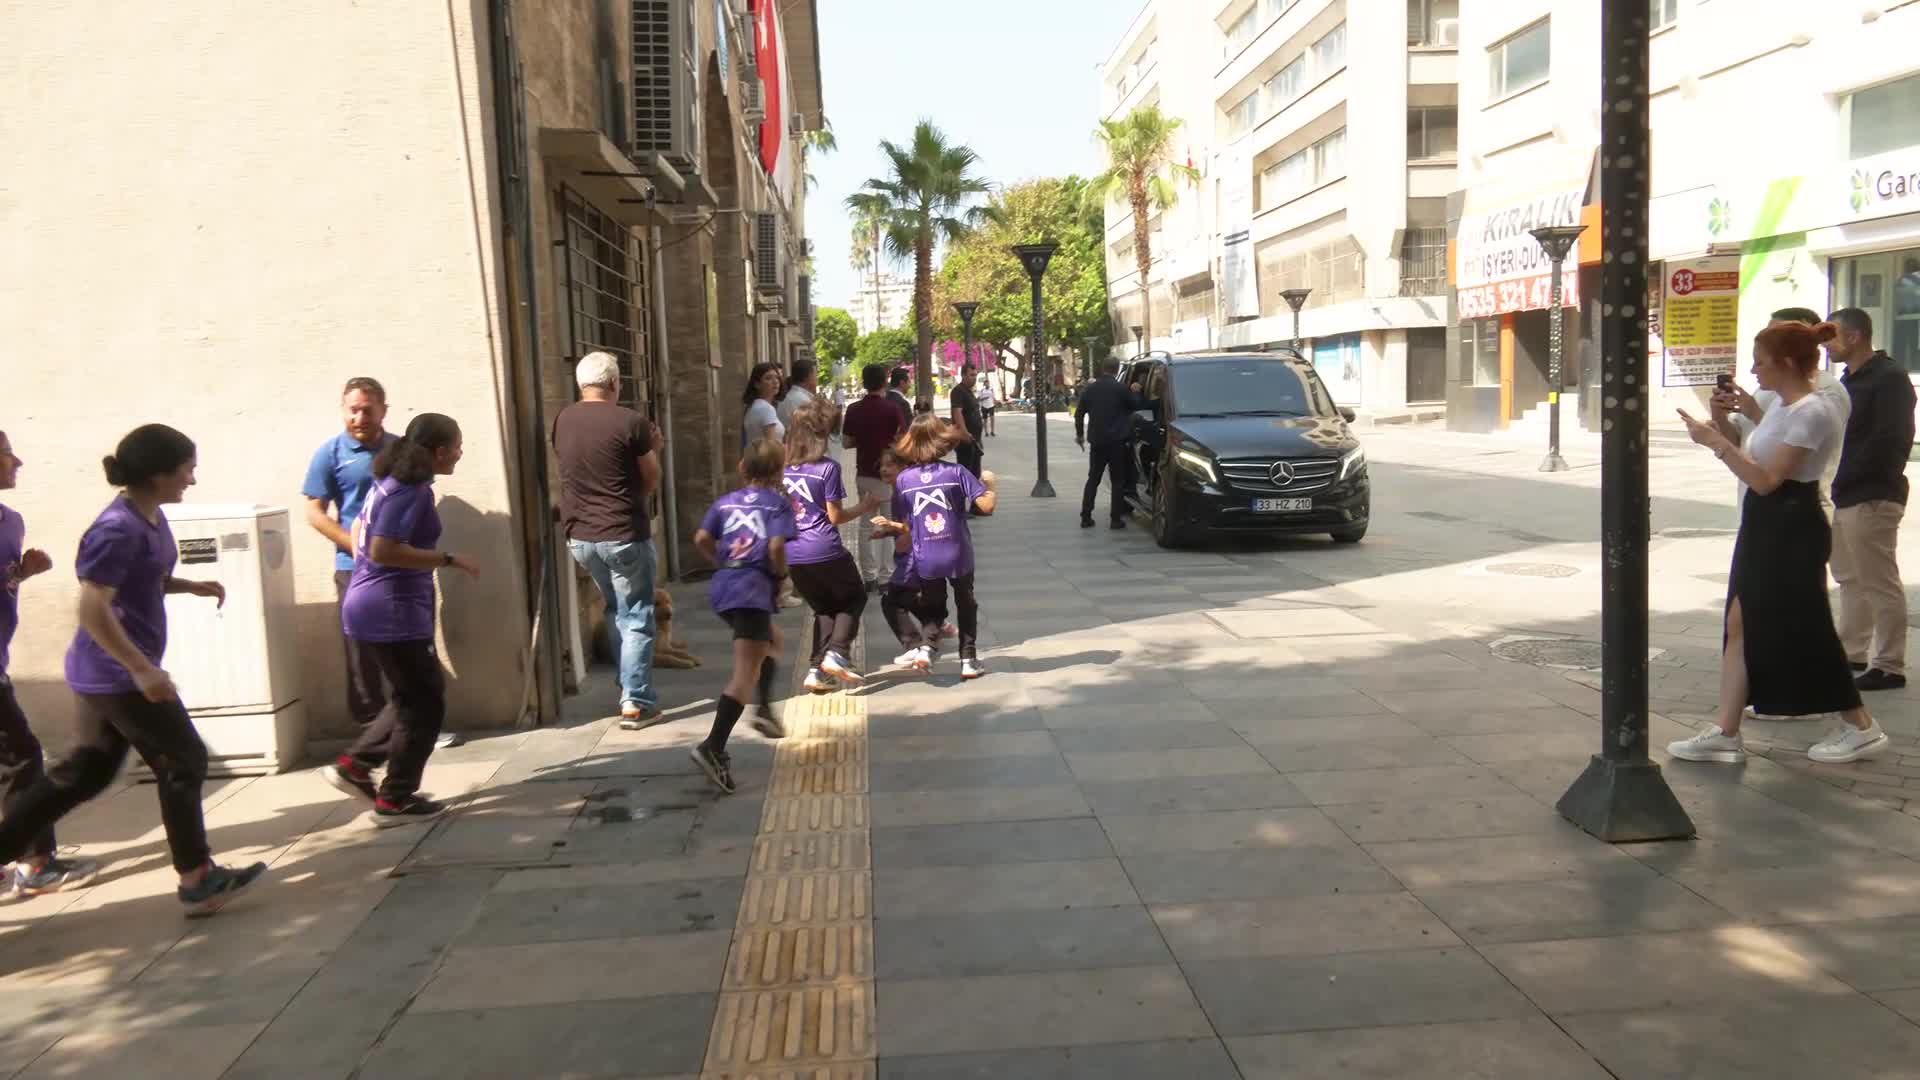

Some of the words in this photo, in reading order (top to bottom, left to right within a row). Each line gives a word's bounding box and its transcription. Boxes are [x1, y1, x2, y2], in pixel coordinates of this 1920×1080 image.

[1675, 273, 1693, 292] 33
[1258, 499, 1270, 510] 33
[1276, 499, 1290, 510] HZ
[1295, 498, 1311, 509] 210
